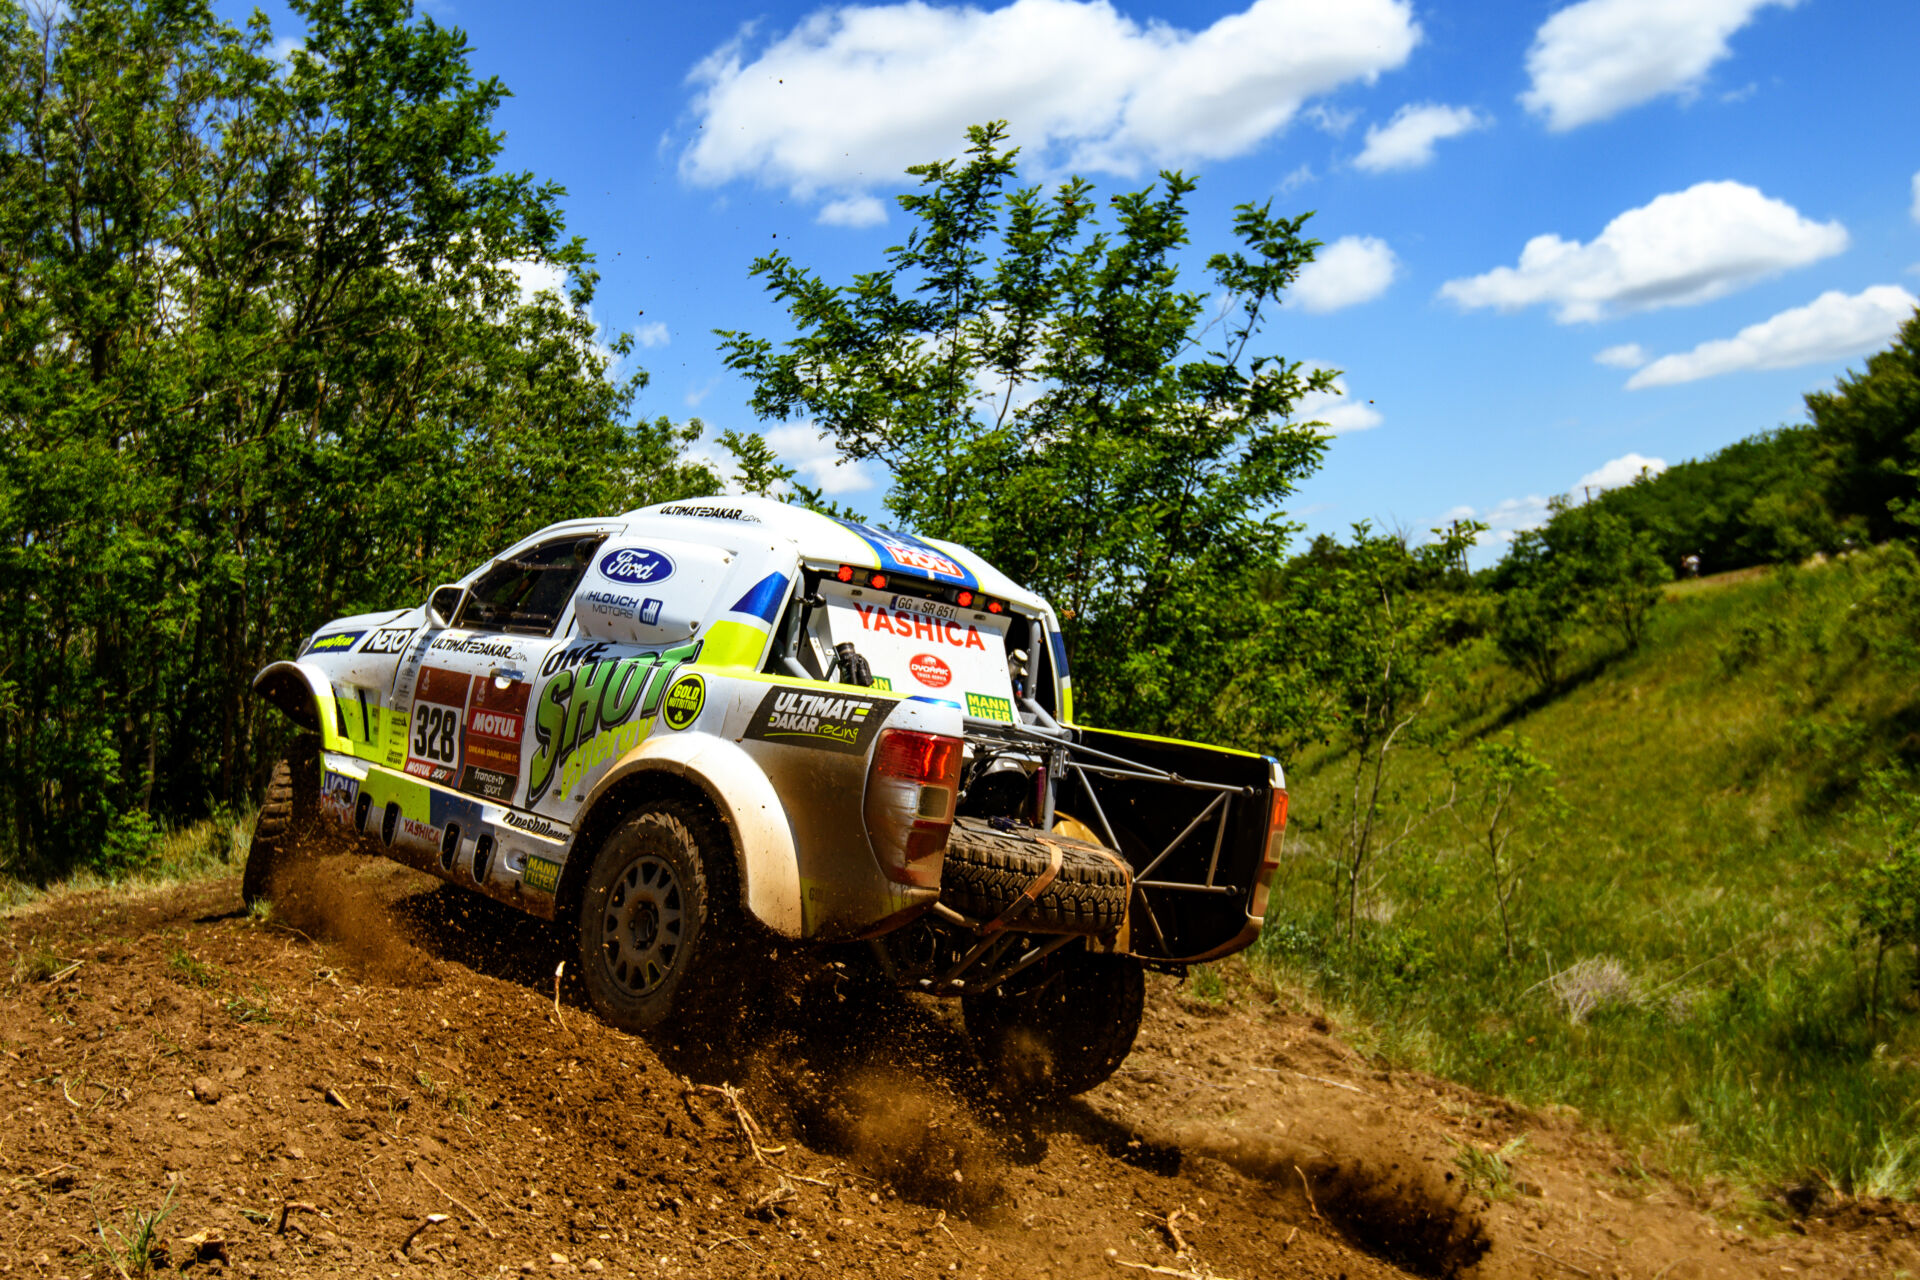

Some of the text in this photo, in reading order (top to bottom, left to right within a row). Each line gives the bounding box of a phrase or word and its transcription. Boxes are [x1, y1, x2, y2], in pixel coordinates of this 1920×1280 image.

[606, 549, 660, 580] Ford
[889, 547, 957, 574] MOLY
[588, 591, 640, 609] HLOUCH
[898, 597, 954, 618] GG SR 851
[592, 603, 634, 619] MOTORS
[853, 602, 986, 651] YASHICA
[542, 641, 617, 677] ONE
[673, 684, 700, 700] GOLD
[967, 694, 1009, 711] MANN
[668, 697, 697, 711] NUTRITION
[774, 692, 873, 723] ULTIMATE
[472, 712, 516, 738] MOTUL
[525, 639, 704, 809] SHOT
[969, 707, 1011, 723] FILTER
[414, 704, 456, 763] 328
[767, 712, 859, 744] DAKAR racing
[407, 761, 431, 776] MOTUL
[484, 784, 502, 796] sport
[404, 820, 439, 843] YASHICA
[528, 857, 559, 877] MANN
[526, 870, 555, 890] FILTER
